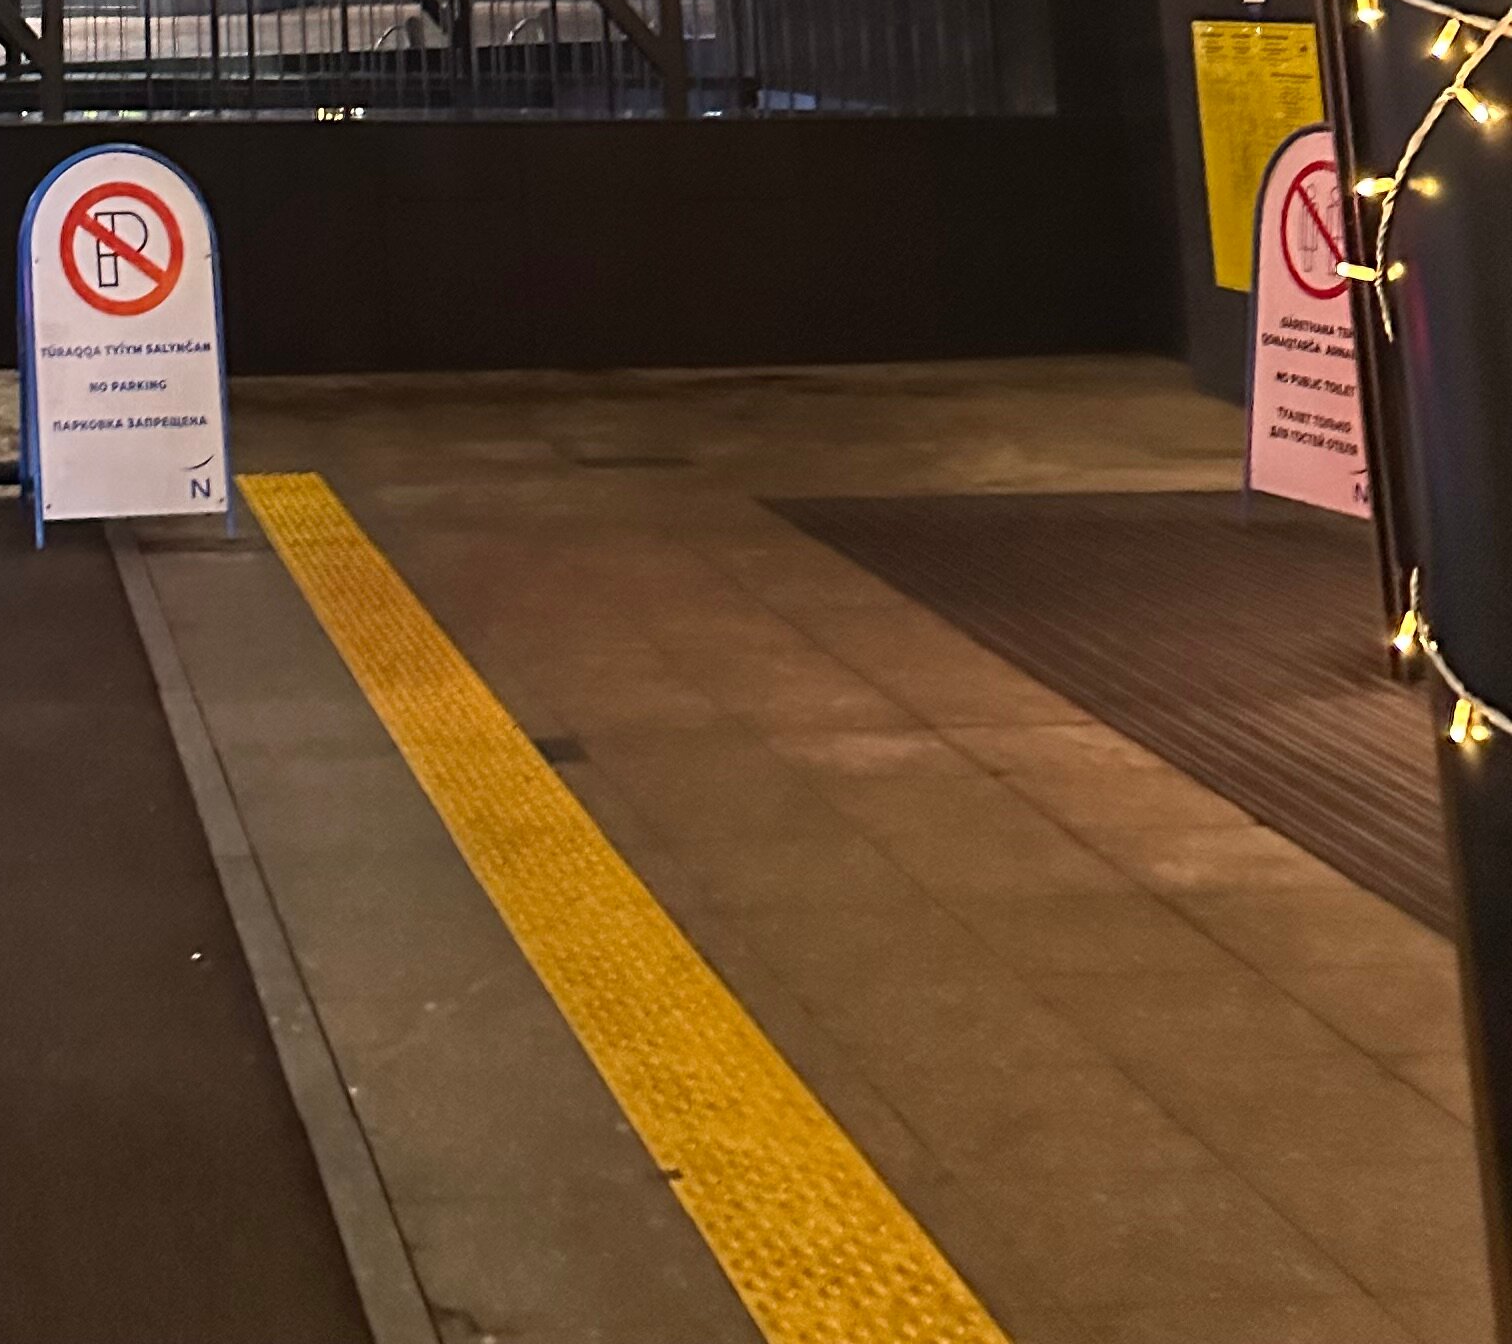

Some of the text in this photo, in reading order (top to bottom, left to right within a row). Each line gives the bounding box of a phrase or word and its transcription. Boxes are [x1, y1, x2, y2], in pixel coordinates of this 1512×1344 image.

[89, 379, 168, 393] NO PARKING
[53, 415, 208, 432] ПАРКОВКА ЗАПРЕЩЕНА
[190, 478, 212, 500] N
